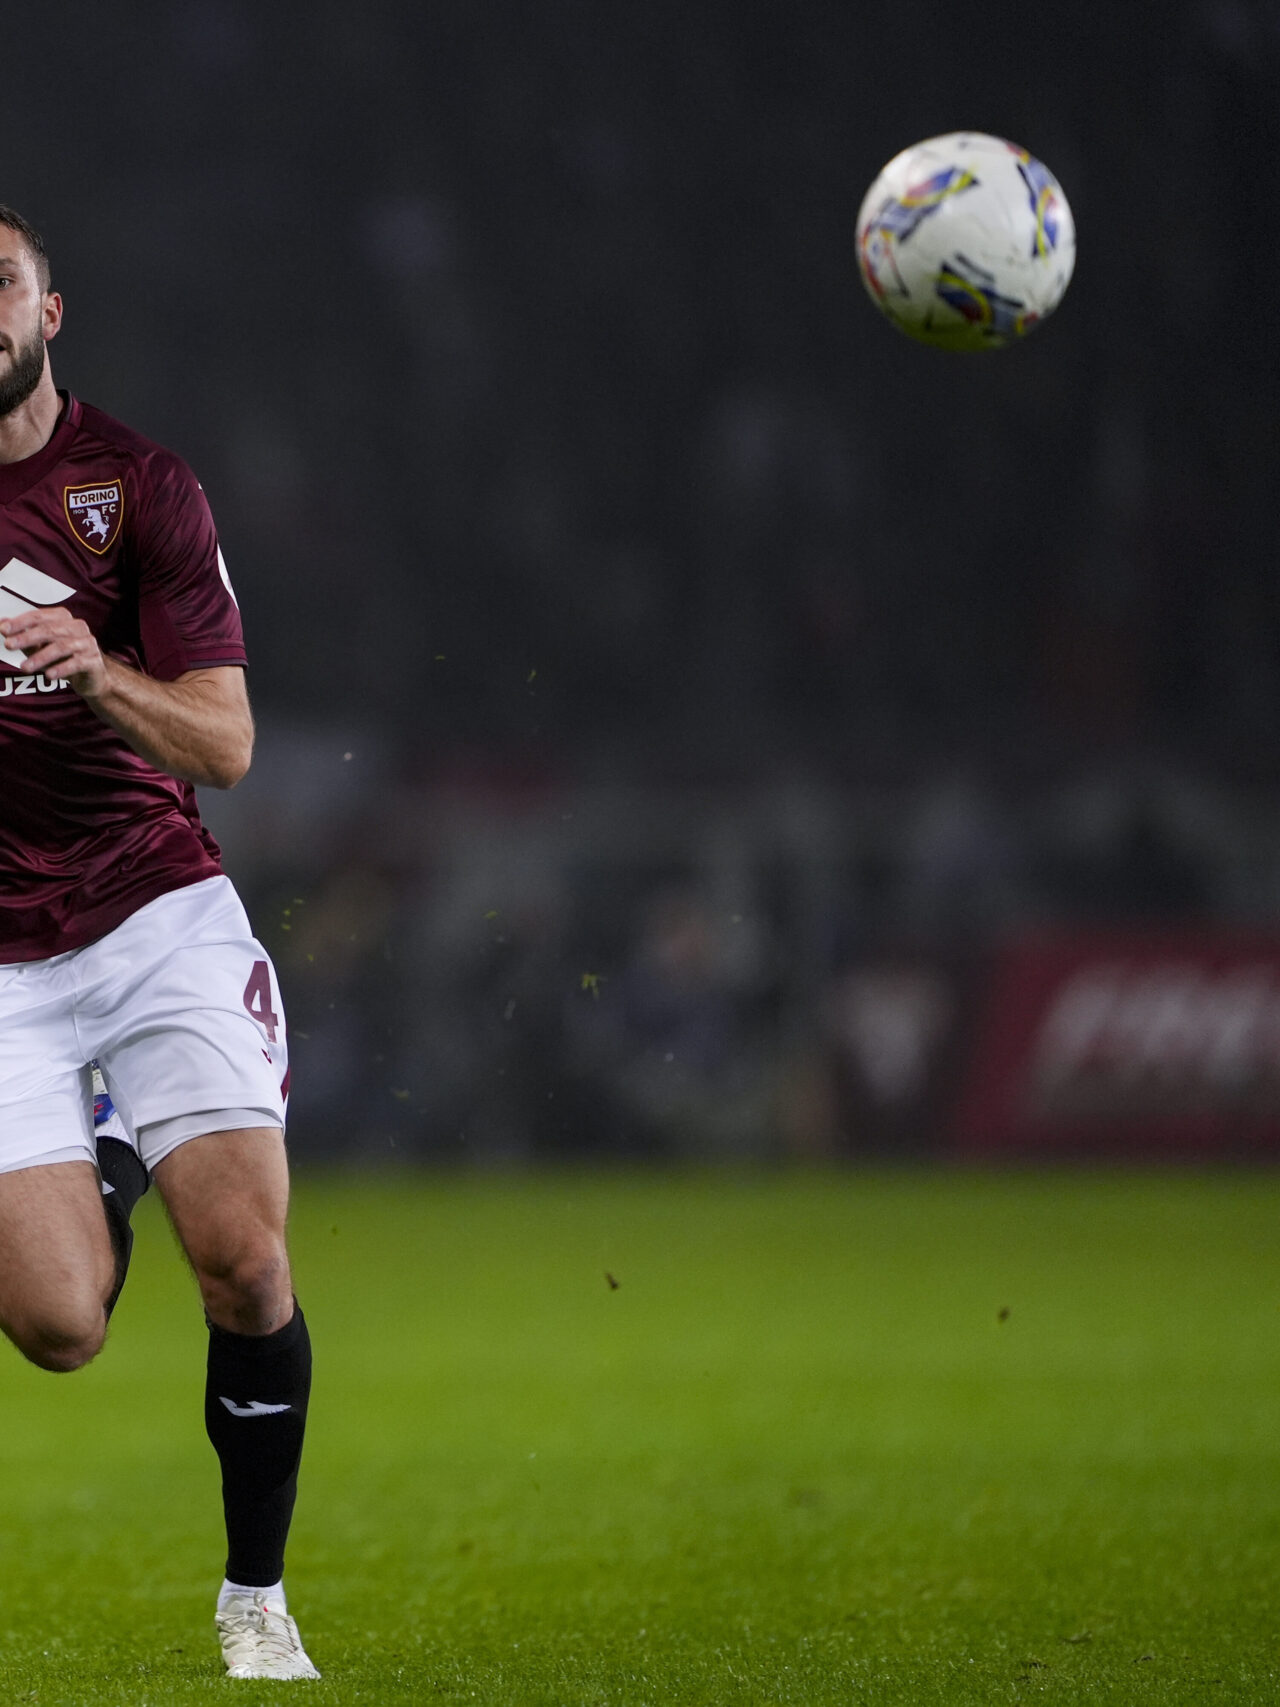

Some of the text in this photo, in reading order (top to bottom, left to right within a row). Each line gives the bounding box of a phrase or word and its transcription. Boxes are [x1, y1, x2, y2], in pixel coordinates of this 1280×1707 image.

[72, 490, 116, 506] TORINO
[101, 503, 117, 515] FC
[243, 960, 279, 1044] 4
